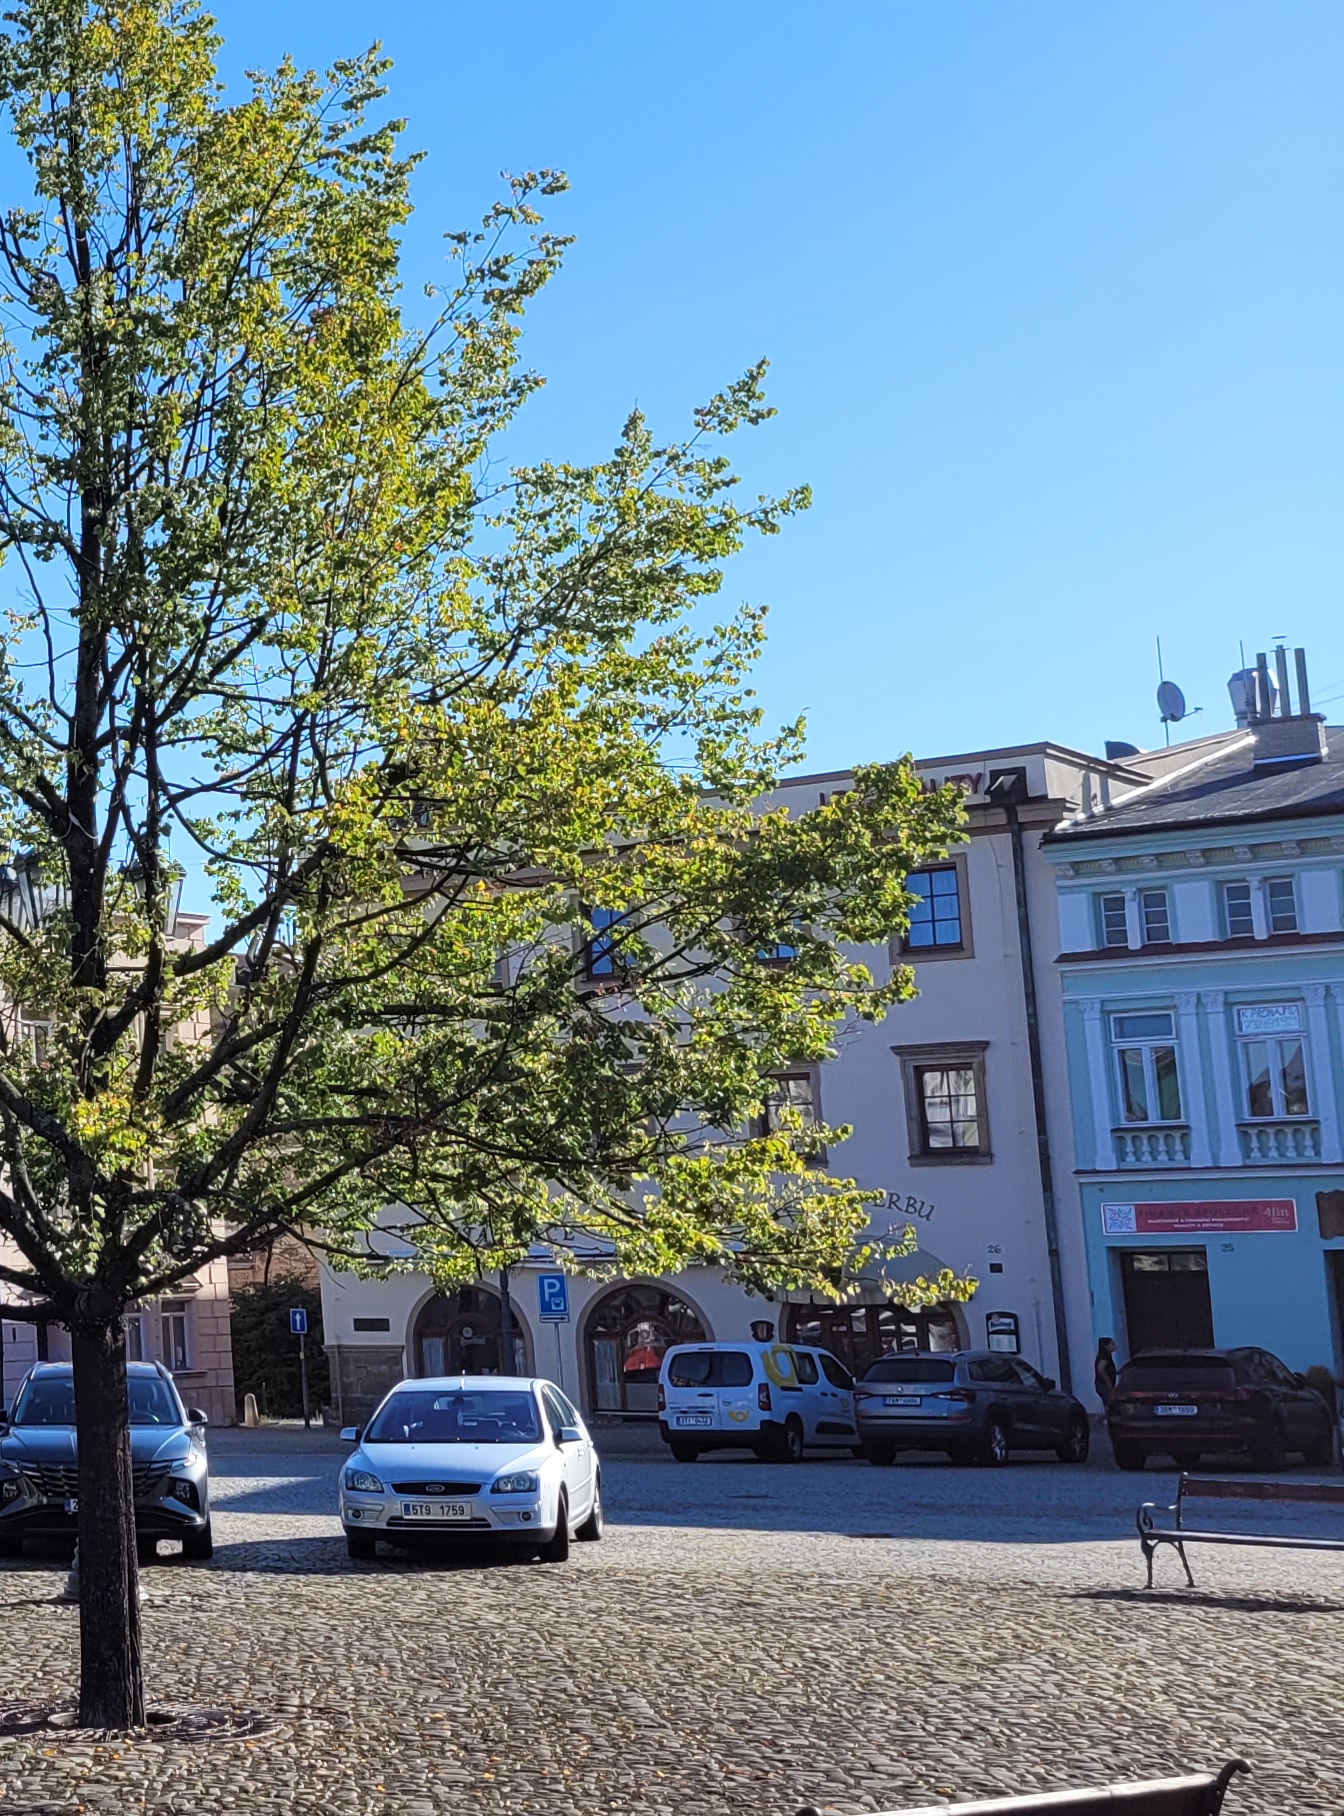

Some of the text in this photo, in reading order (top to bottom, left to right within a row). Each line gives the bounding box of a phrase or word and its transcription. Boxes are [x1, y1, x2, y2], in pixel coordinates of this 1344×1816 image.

[987, 1244, 1001, 1254] 26
[1221, 1243, 1235, 1252] 25
[411, 1504, 465, 1516] 5T9 1759
